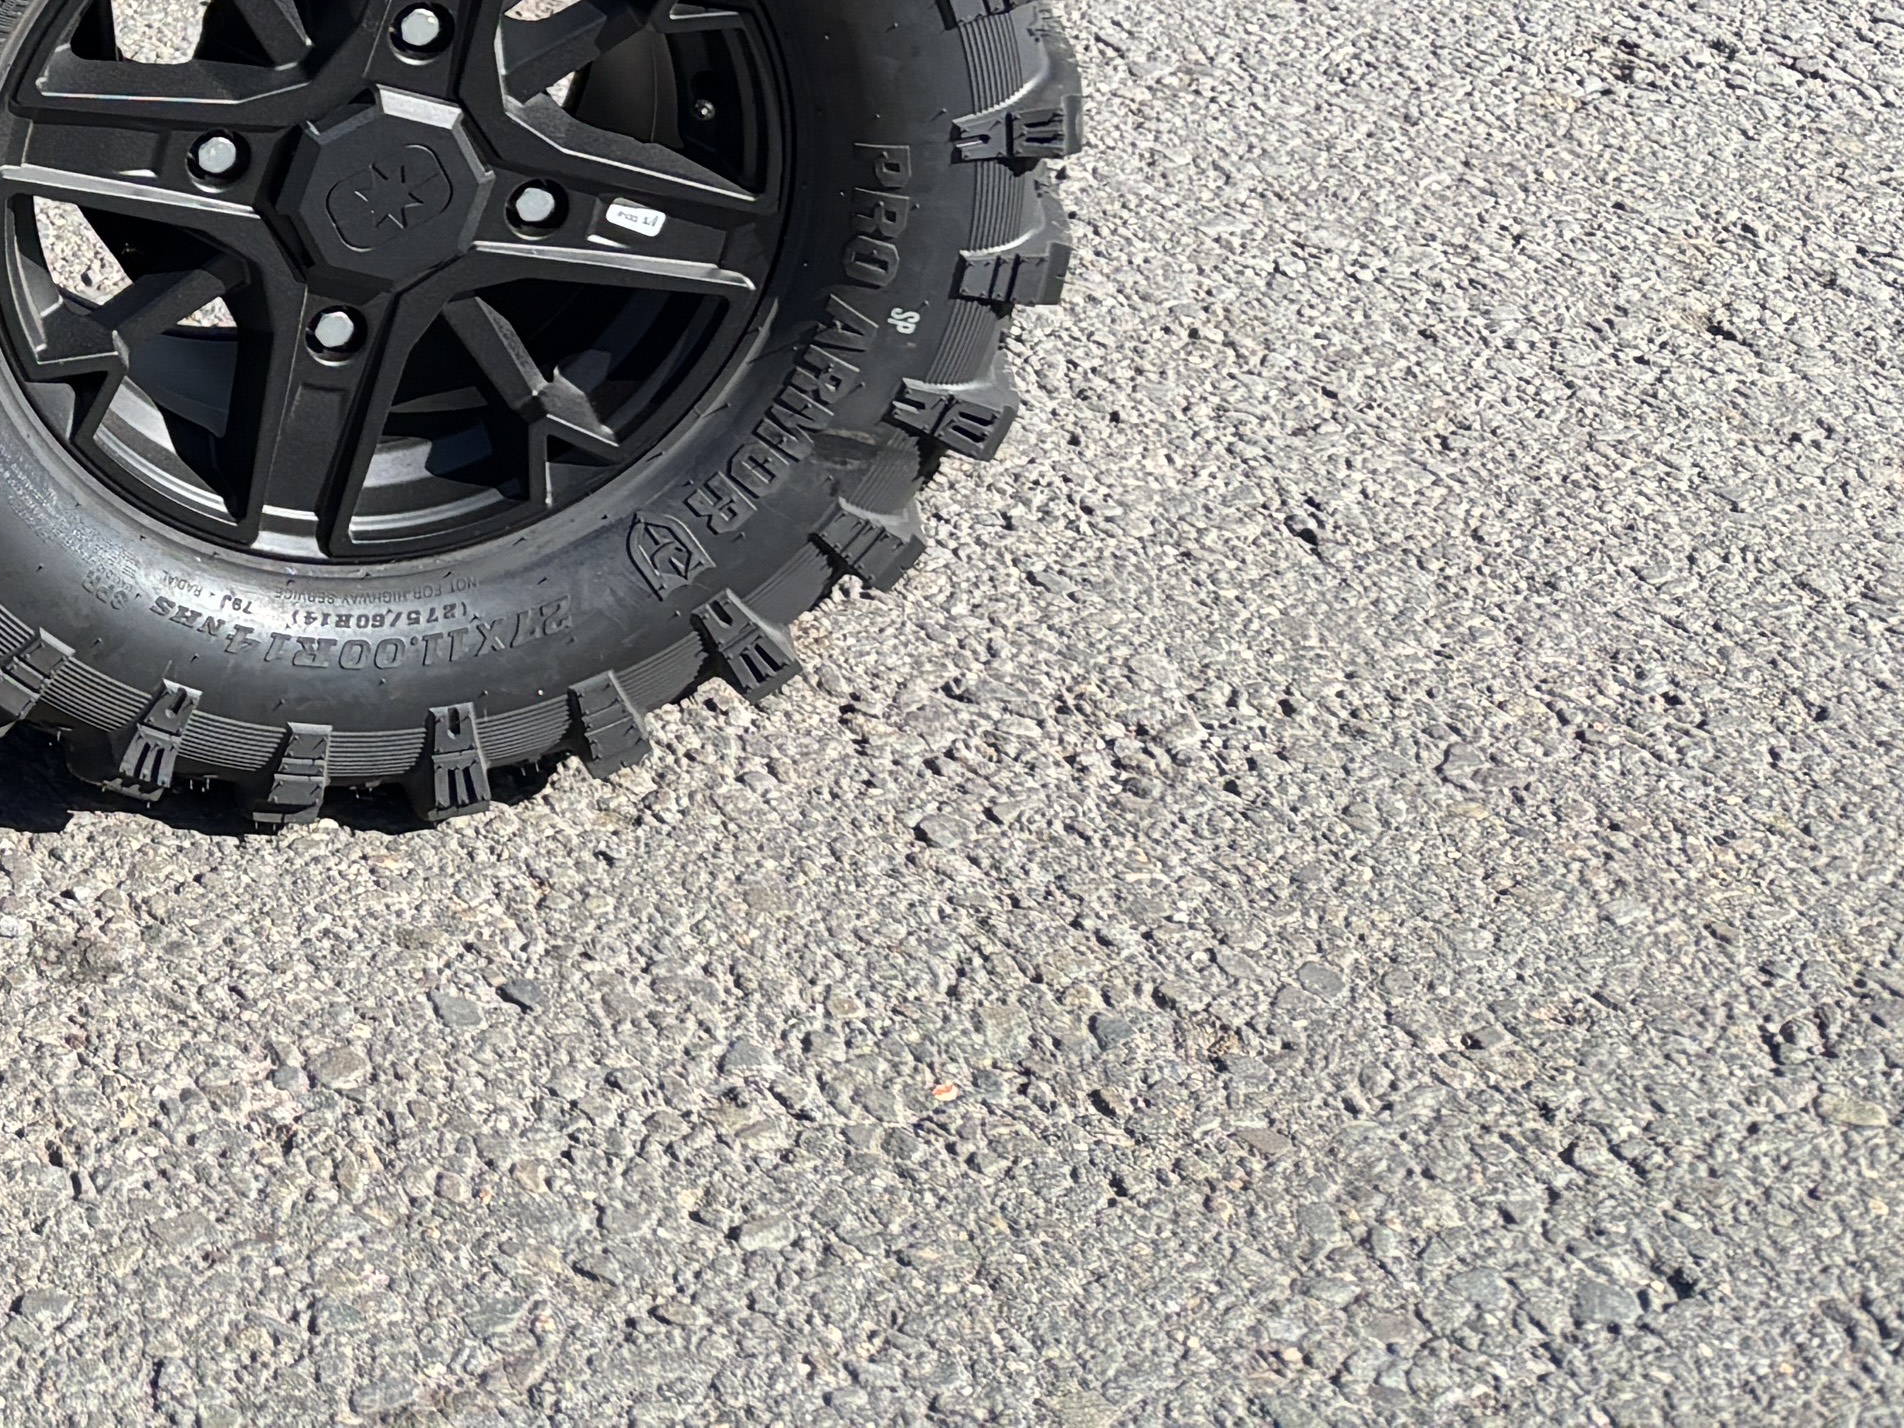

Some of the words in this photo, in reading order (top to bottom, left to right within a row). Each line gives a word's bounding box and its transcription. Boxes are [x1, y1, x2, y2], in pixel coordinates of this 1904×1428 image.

[842, 142, 913, 290] PRO
[682, 292, 880, 536] ARMOR
[274, 584, 335, 606] SERVICE
[337, 587, 411, 606] HIGHWAY
[414, 580, 445, 599] FOR
[148, 593, 224, 639] NHS
[291, 600, 468, 631] (275/60R14)
